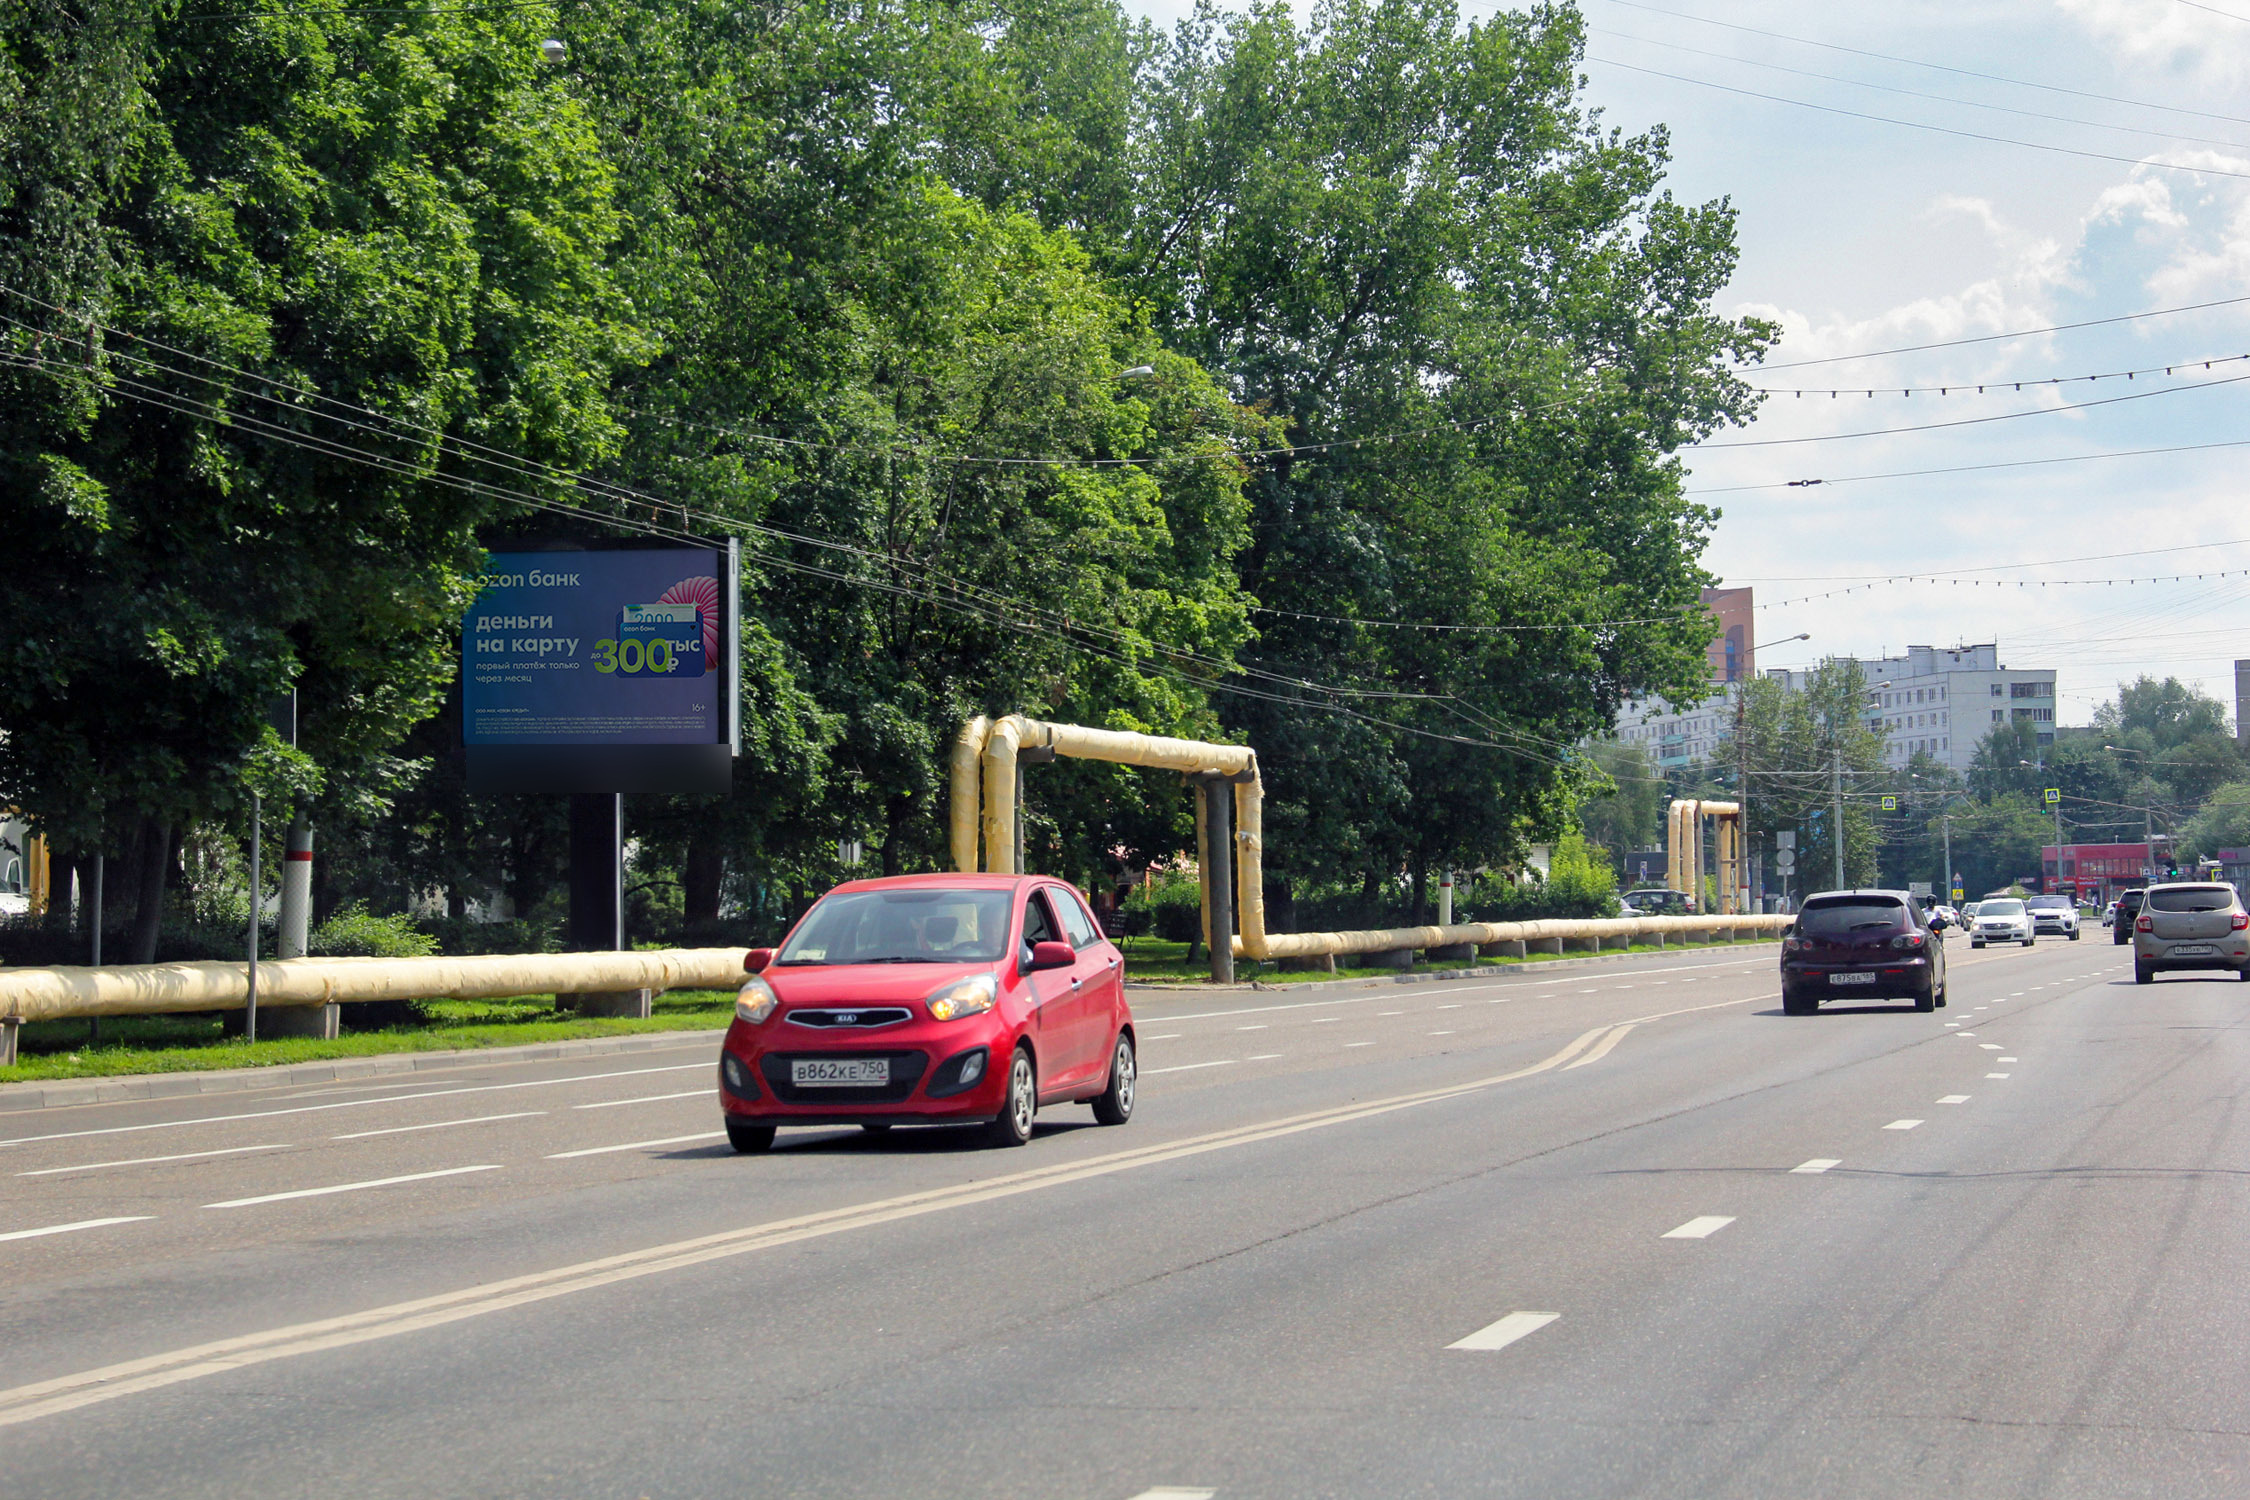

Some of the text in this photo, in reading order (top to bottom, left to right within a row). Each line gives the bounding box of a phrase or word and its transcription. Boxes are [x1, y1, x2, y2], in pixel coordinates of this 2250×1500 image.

[475, 569, 581, 588] ozon банк
[475, 614, 553, 633] деньги
[476, 637, 580, 657] на карту
[590, 651, 602, 660] до
[594, 638, 673, 674] 300
[475, 661, 581, 672] первый платёж только
[475, 675, 533, 684] через месяц
[692, 703, 706, 713] 16+
[798, 1061, 885, 1080] В862КЕ 750
